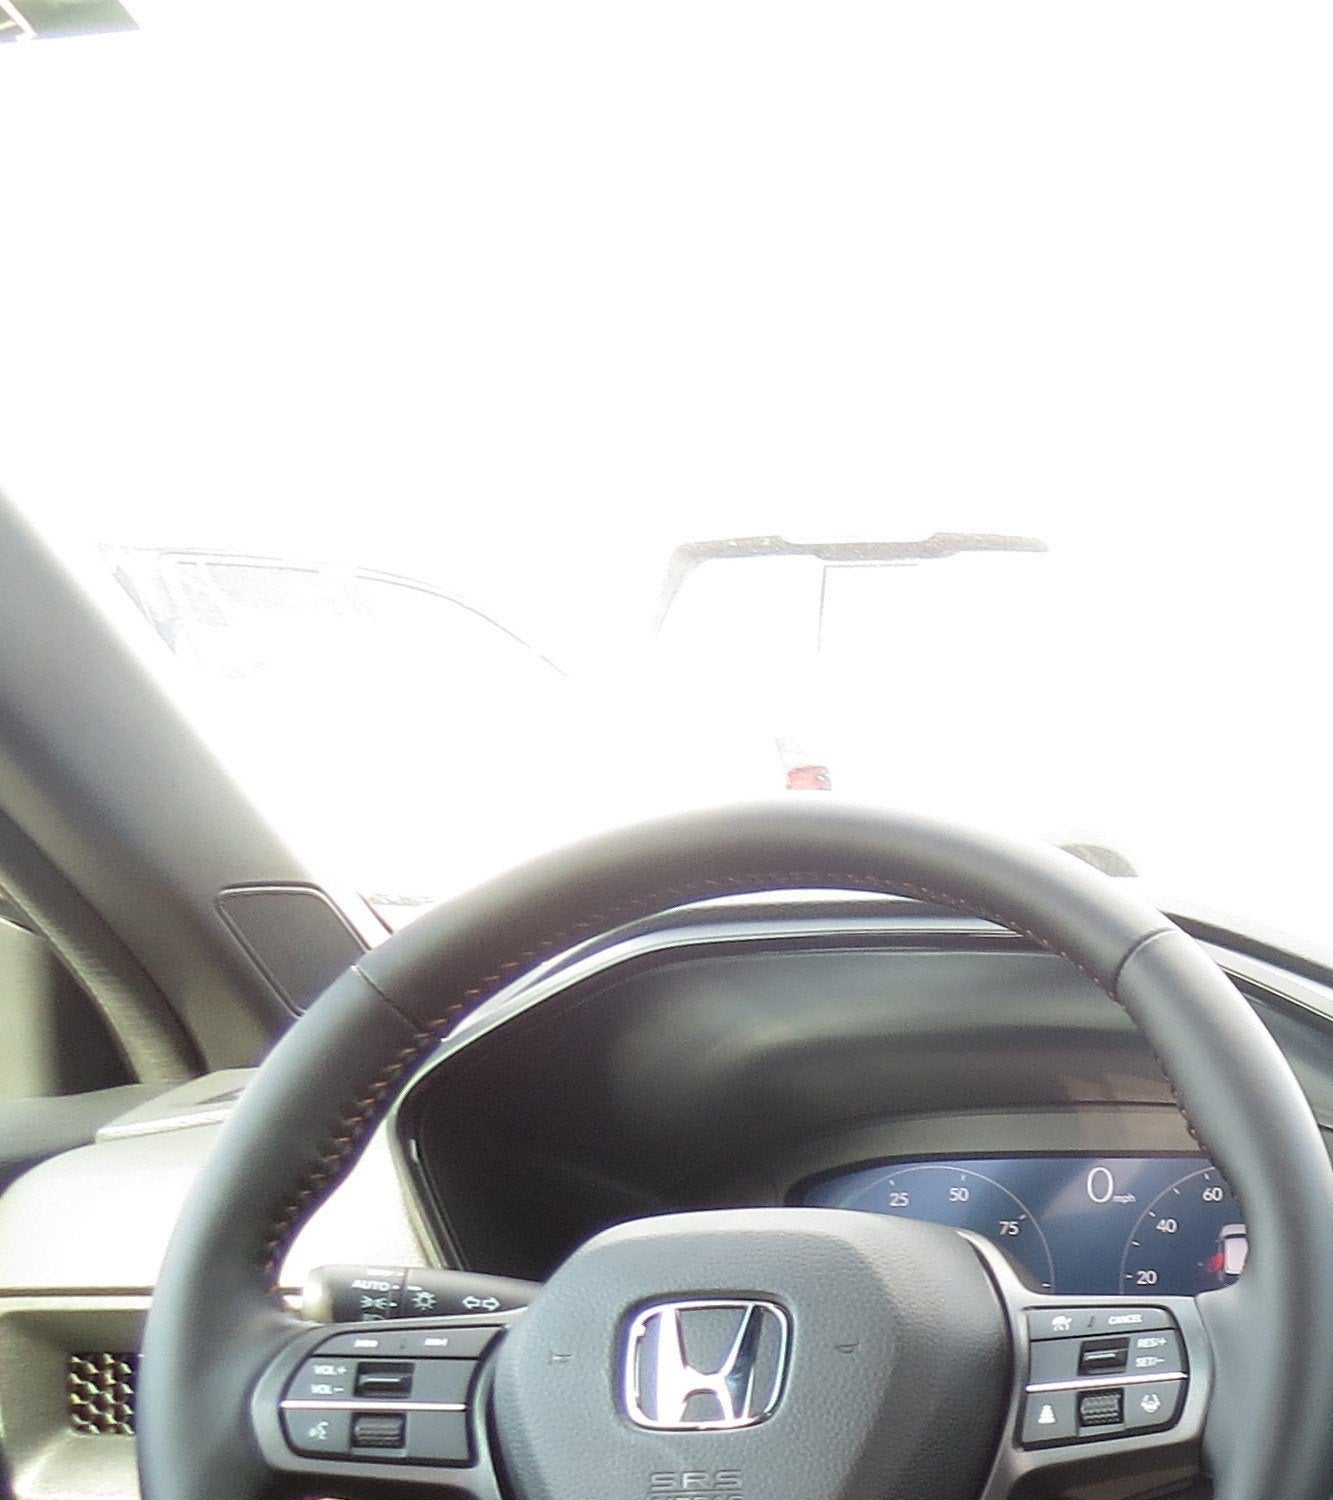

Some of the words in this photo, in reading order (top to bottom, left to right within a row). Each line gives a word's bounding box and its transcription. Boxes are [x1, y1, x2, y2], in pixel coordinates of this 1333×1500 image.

[1087, 1166, 1113, 1205] 0
[889, 1192, 910, 1208] 25
[949, 1187, 970, 1203] 50
[1202, 1187, 1223, 1203] 60
[1000, 1220, 1020, 1236] 75
[1156, 1218, 1178, 1234] 40
[351, 1279, 390, 1291] AUTO
[1137, 1270, 1158, 1286] 20
[649, 1469, 743, 1490] SRS
